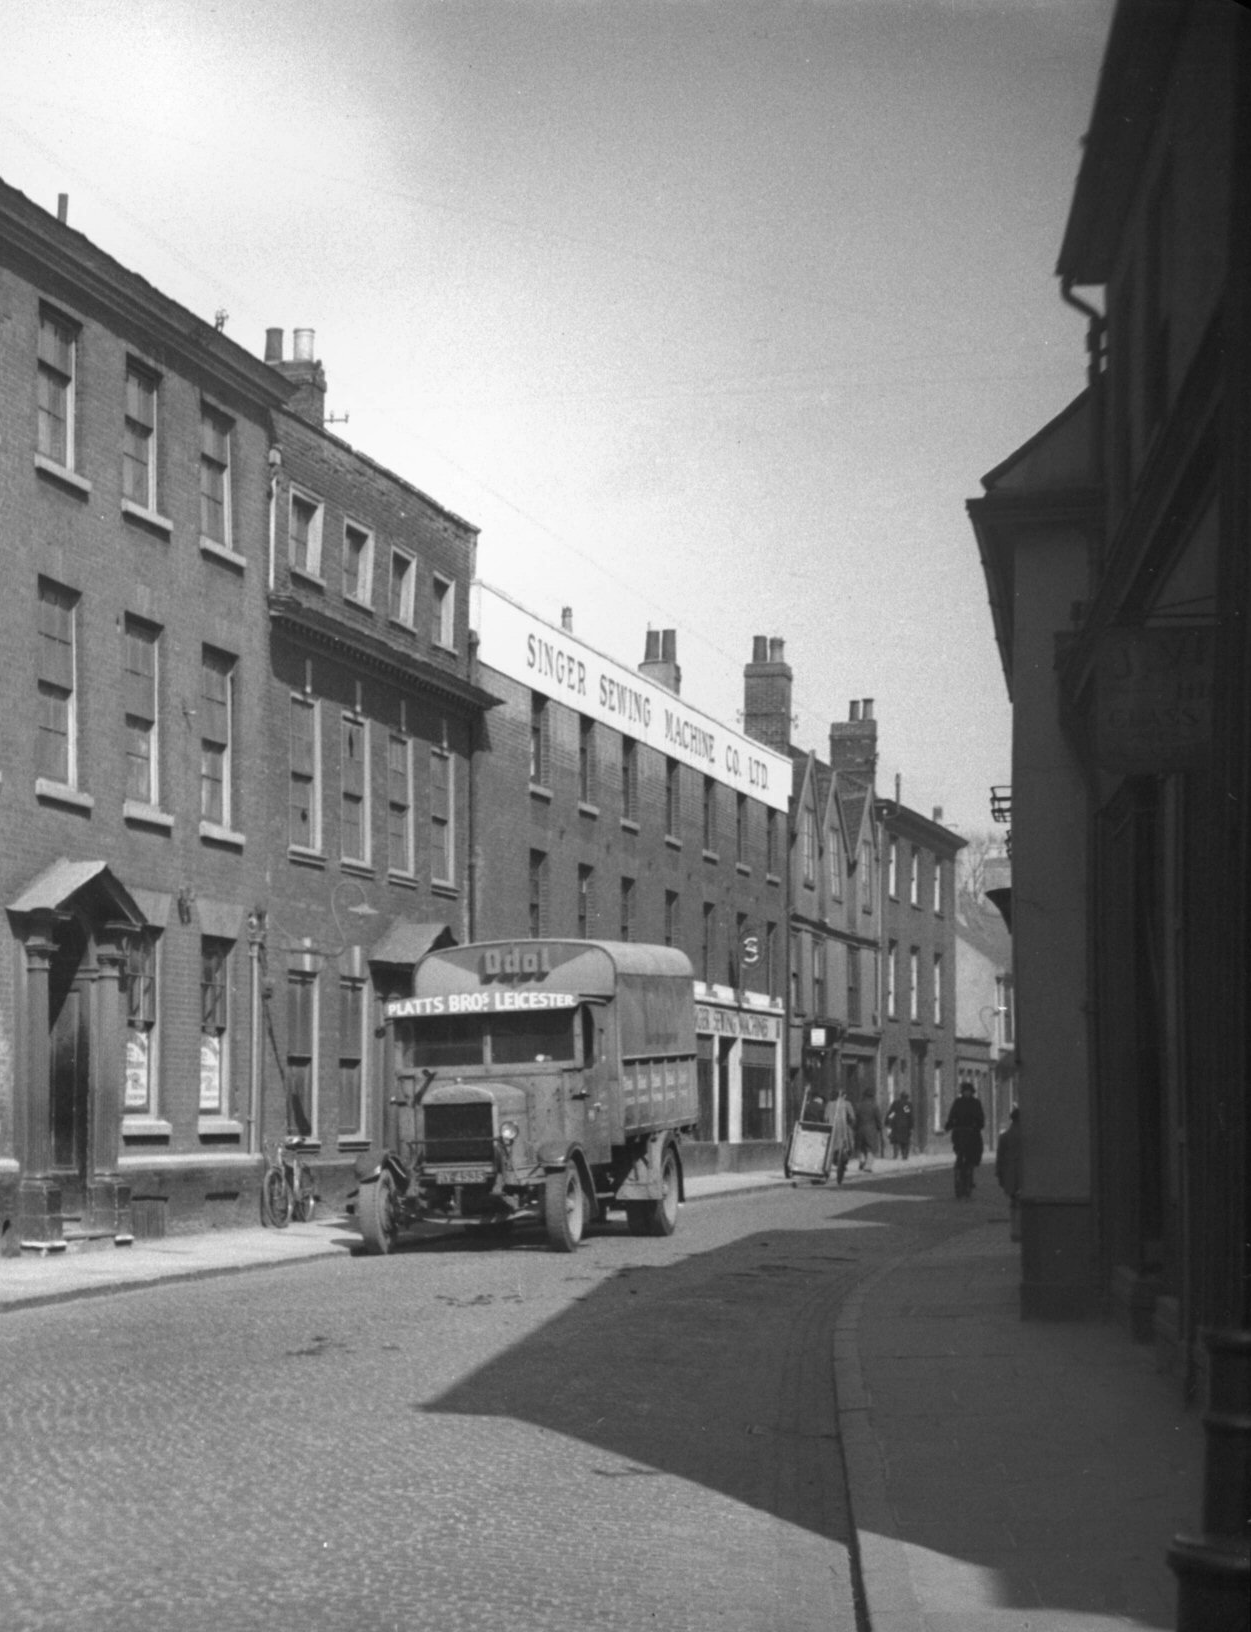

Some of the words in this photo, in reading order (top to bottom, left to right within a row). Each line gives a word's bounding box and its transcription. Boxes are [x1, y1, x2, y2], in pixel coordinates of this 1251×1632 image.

[527, 633, 587, 696] SINGER
[599, 673, 651, 728] SEWING
[664, 708, 715, 763] MACHINE
[388, 996, 444, 1016] PLATTS
[495, 991, 576, 1010] LEICESTER
